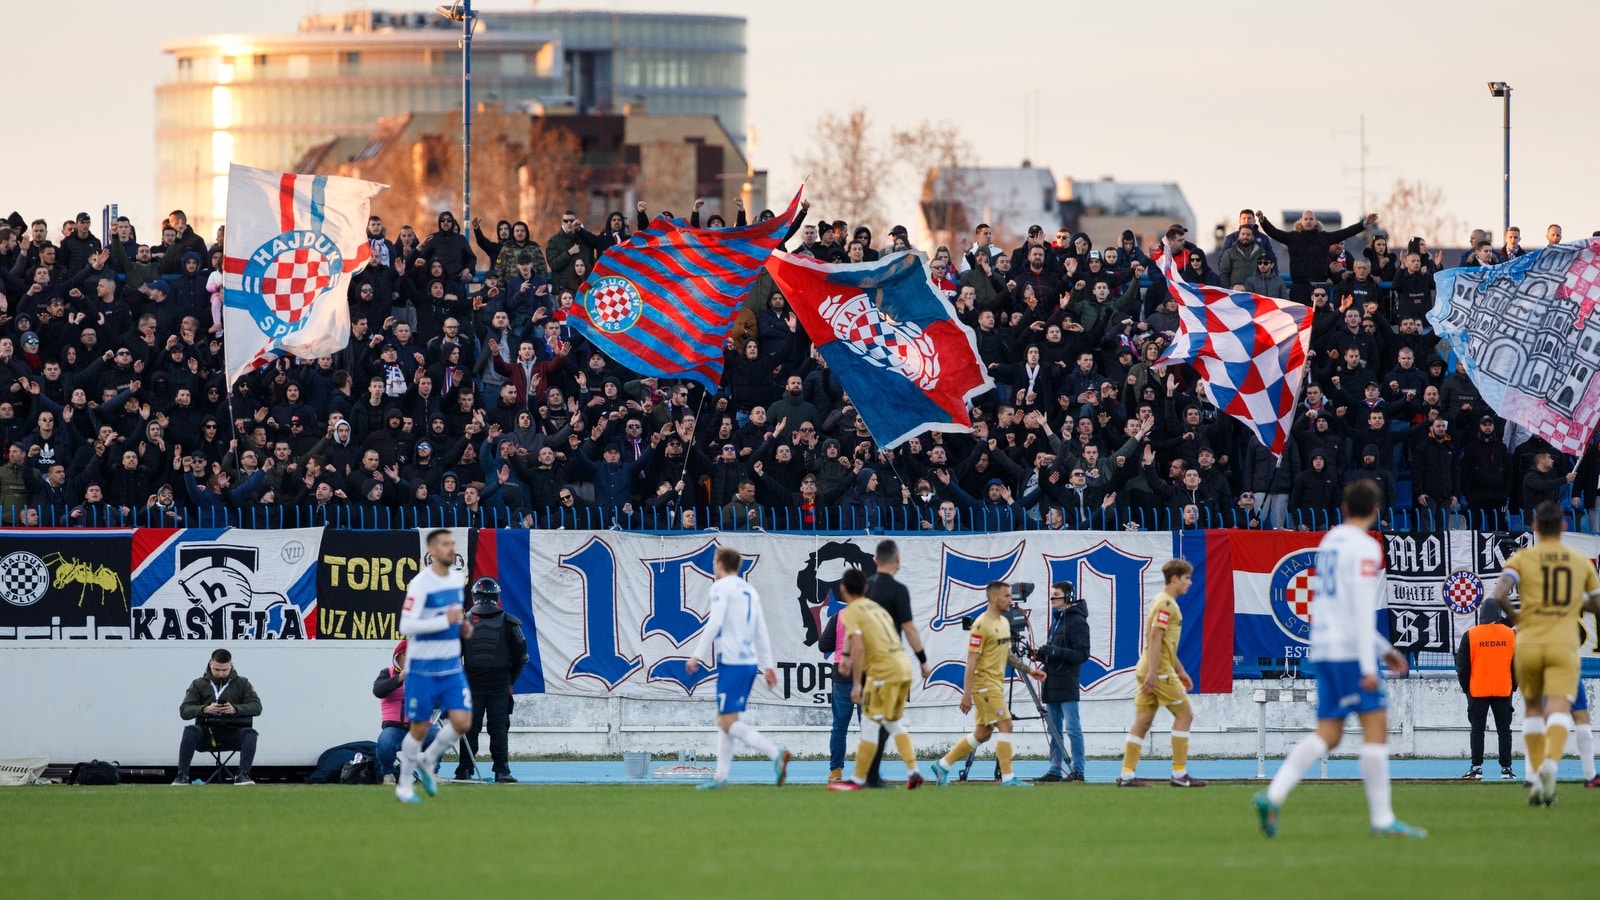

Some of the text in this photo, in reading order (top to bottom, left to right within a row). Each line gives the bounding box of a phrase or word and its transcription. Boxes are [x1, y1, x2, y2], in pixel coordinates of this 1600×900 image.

[253, 231, 340, 266] HAJDUK
[837, 300, 867, 336] HAJ
[1, 555, 42, 571] HAJDUK
[285, 547, 300, 560] VII
[323, 554, 418, 591] TORC
[1446, 571, 1480, 587] HAJDUK
[4, 590, 38, 603] SPLIT
[1394, 584, 1434, 601] WHITE
[1541, 566, 1572, 606] 10
[743, 590, 752, 624] 7
[1450, 602, 1478, 614] SPLIT
[320, 607, 347, 638] UZ
